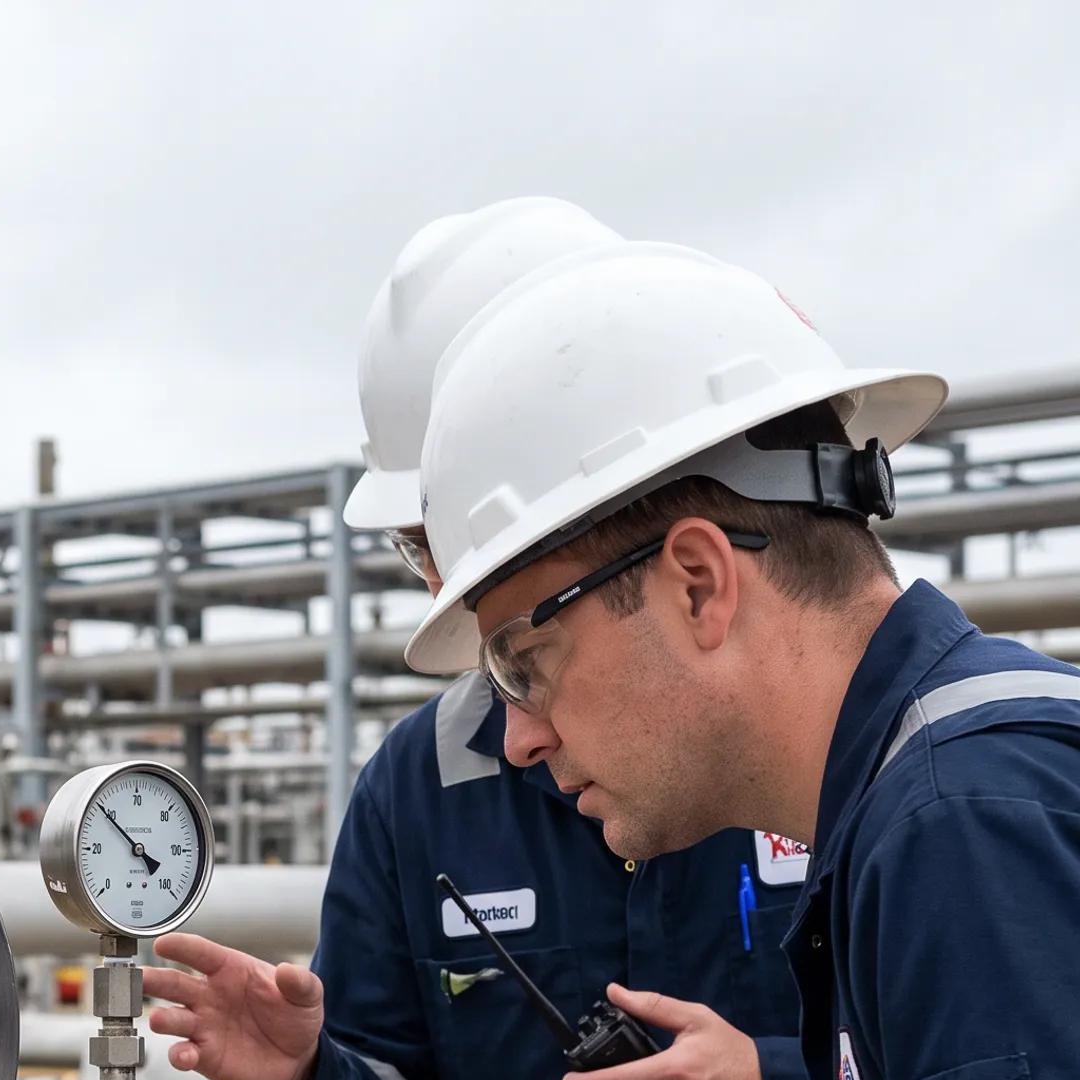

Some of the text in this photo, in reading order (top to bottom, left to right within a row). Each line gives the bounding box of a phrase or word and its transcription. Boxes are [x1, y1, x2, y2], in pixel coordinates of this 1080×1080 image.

[132, 794, 142, 806] 70
[160, 810, 169, 822] 80
[92, 842, 102, 855] 20
[105, 877, 111, 890] 0
